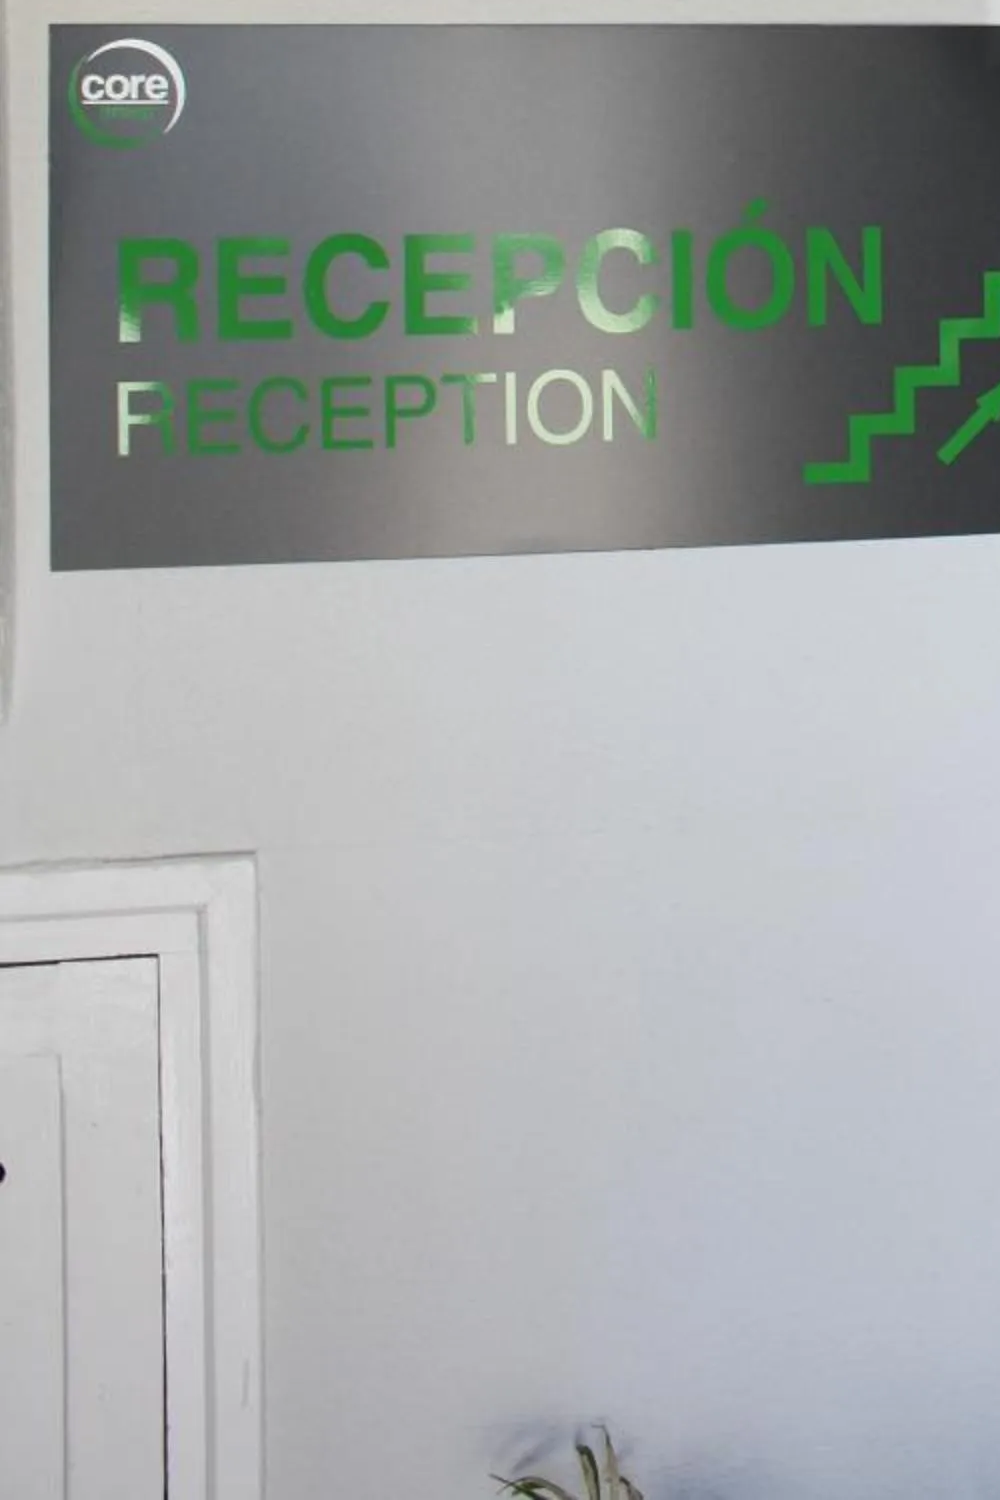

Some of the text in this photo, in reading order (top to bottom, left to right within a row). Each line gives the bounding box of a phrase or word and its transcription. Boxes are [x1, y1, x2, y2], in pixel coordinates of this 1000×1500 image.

[81, 74, 168, 100] core
[117, 198, 882, 343] RECEPCIÓN
[117, 368, 657, 456] RECEPTION
